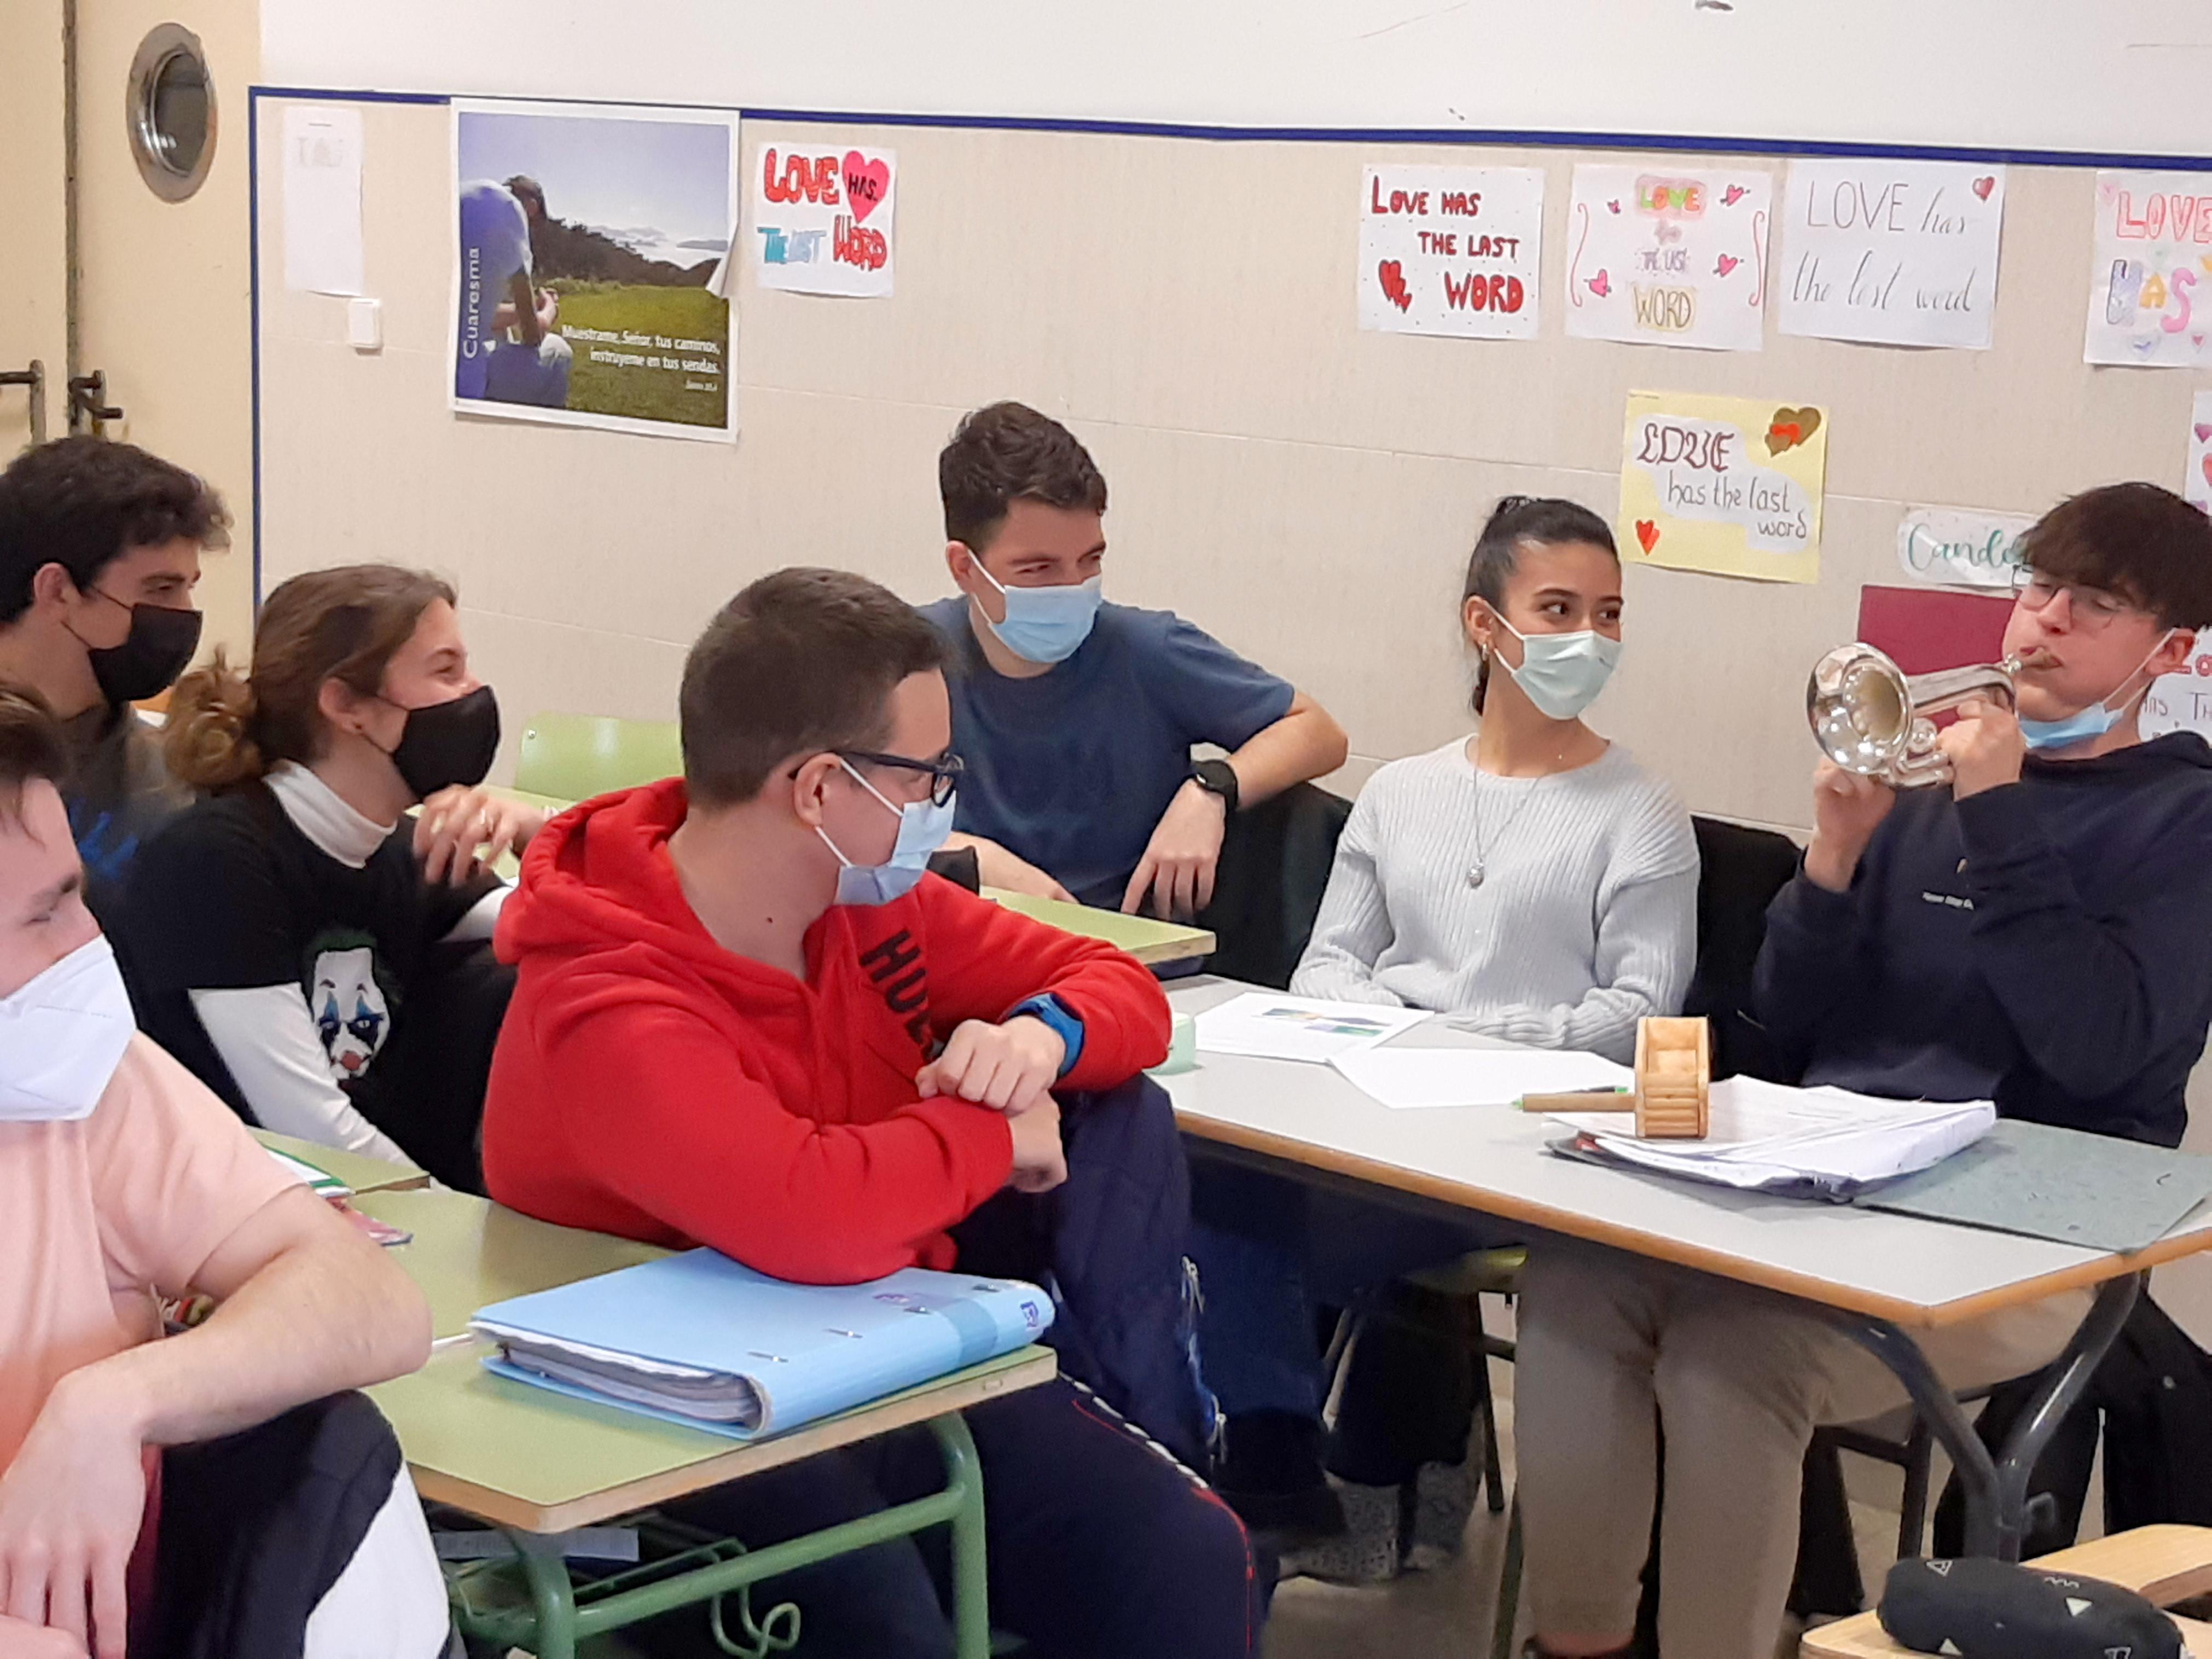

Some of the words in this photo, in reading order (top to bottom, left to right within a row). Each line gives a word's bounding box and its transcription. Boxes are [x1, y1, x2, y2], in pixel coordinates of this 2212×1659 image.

[764, 148, 839, 205] LOVE
[1372, 175, 1429, 215] LOVE
[1441, 191, 1481, 216] HAS
[1640, 185, 1700, 211] LOVE
[1808, 181, 1908, 231] LOVE
[2116, 190, 2212, 244] LOVE
[833, 214, 887, 272] WORD
[1417, 231, 1457, 256] THE
[1467, 235, 1519, 259] LAST
[1444, 271, 1523, 314] WORD
[1634, 286, 1691, 328] WORD
[1668, 469, 1706, 509] has
[1714, 476, 1742, 510] the
[1750, 476, 1791, 513] last
[1757, 508, 1807, 539] word
